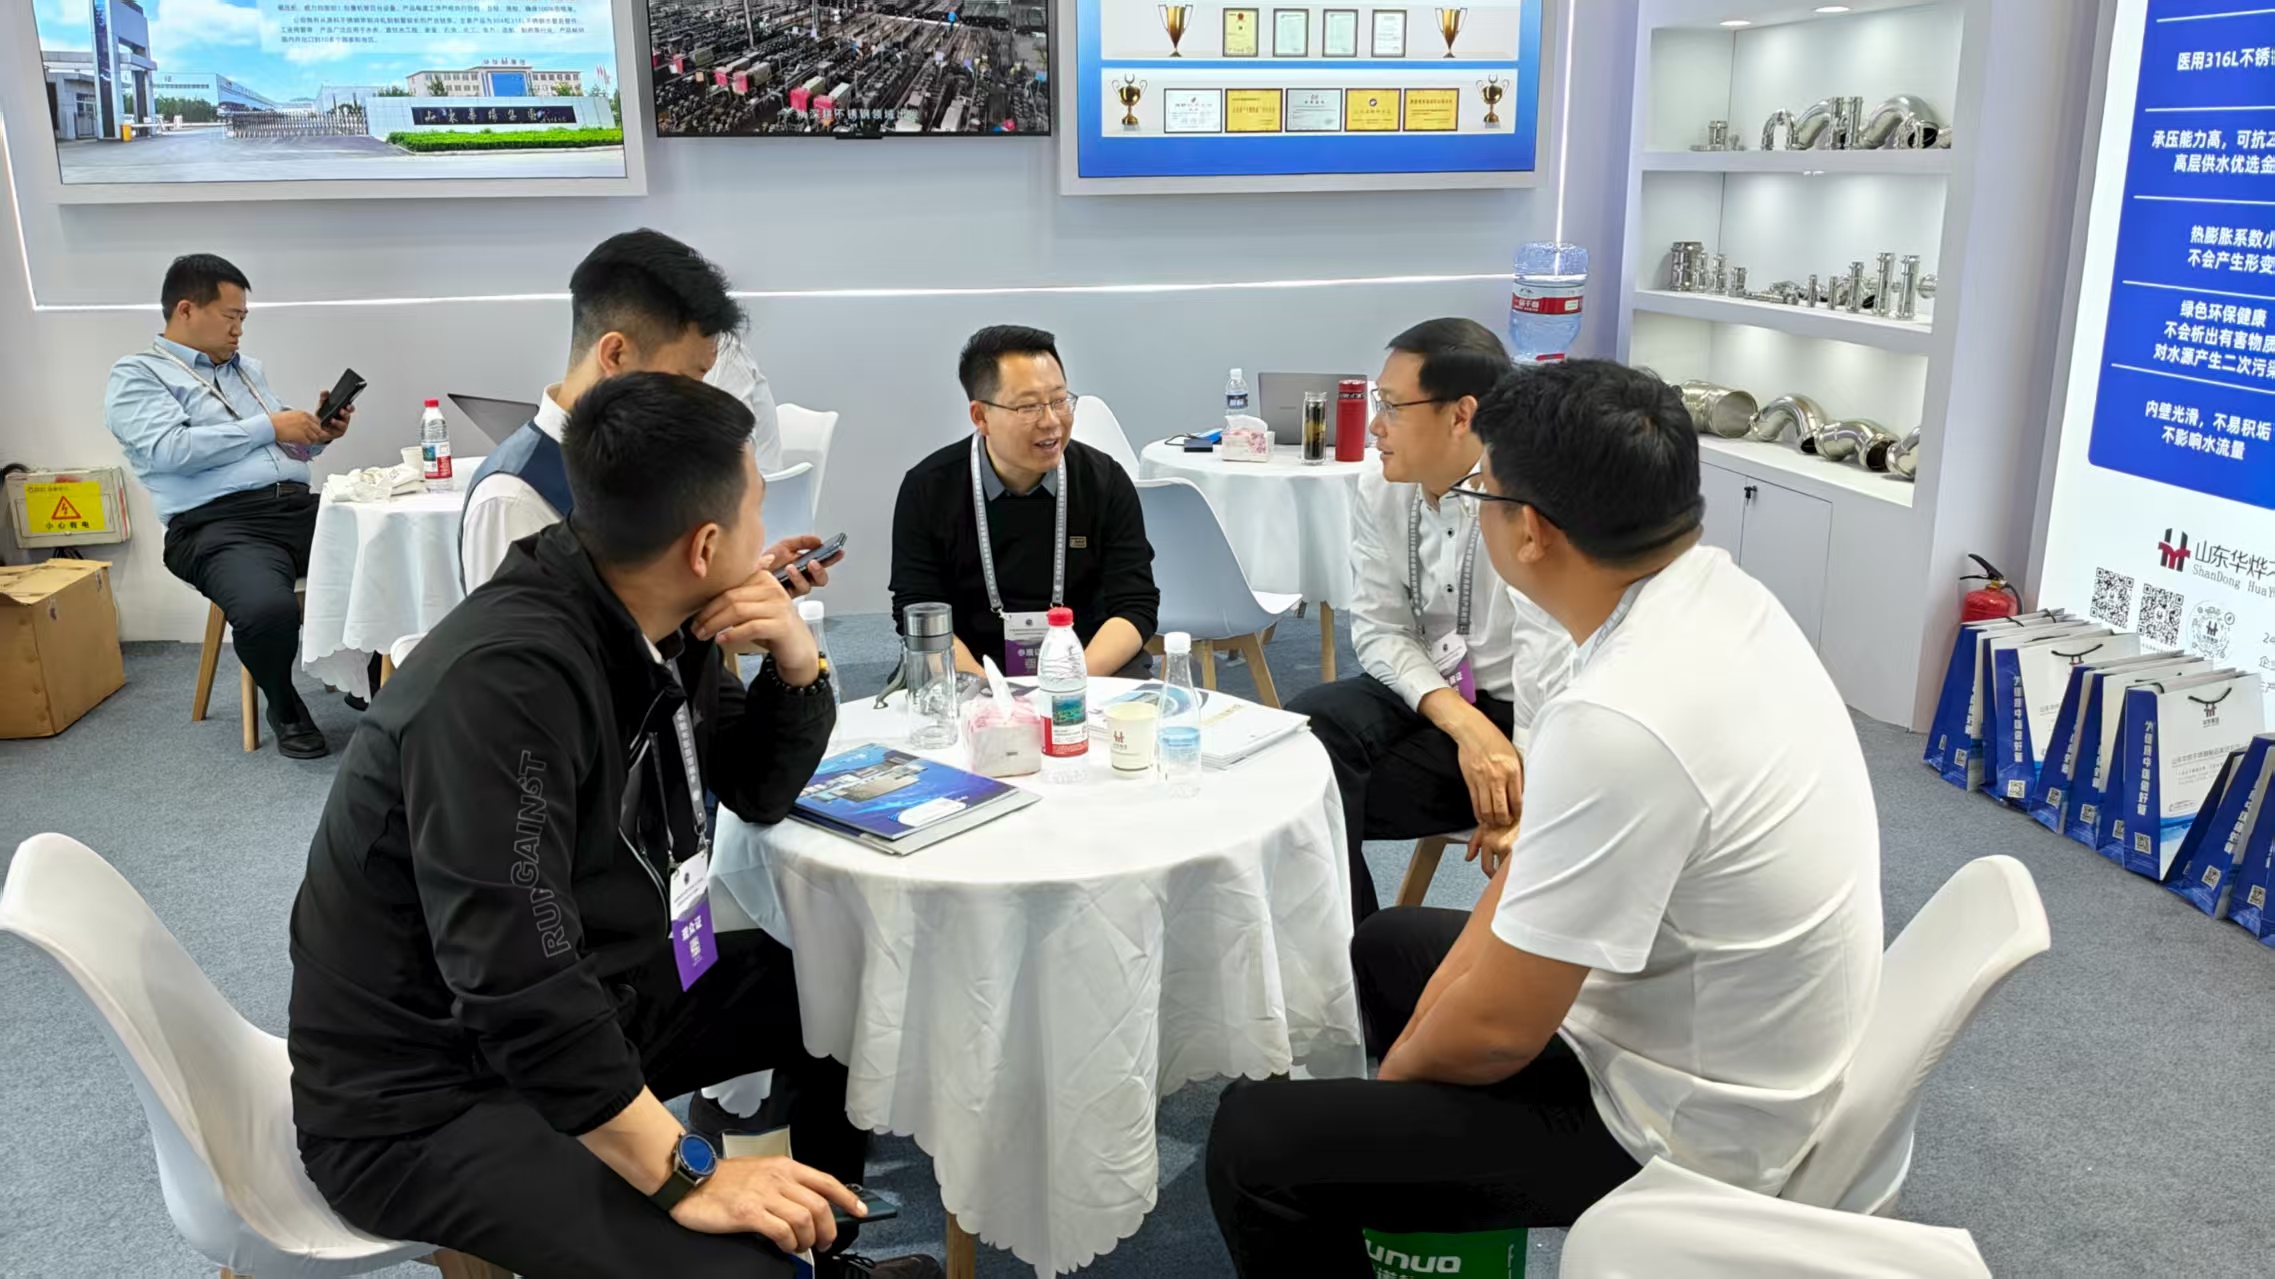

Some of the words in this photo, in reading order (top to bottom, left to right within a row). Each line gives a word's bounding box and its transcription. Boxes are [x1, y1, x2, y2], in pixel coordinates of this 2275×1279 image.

[2174, 153, 2275, 174] 高层供水优选金
[2187, 249, 2275, 275] 不会产生形变
[2180, 299, 2268, 328] 绿色环保健康
[2161, 425, 2245, 460] 不影响水流量
[2192, 563, 2241, 590] ShanDong
